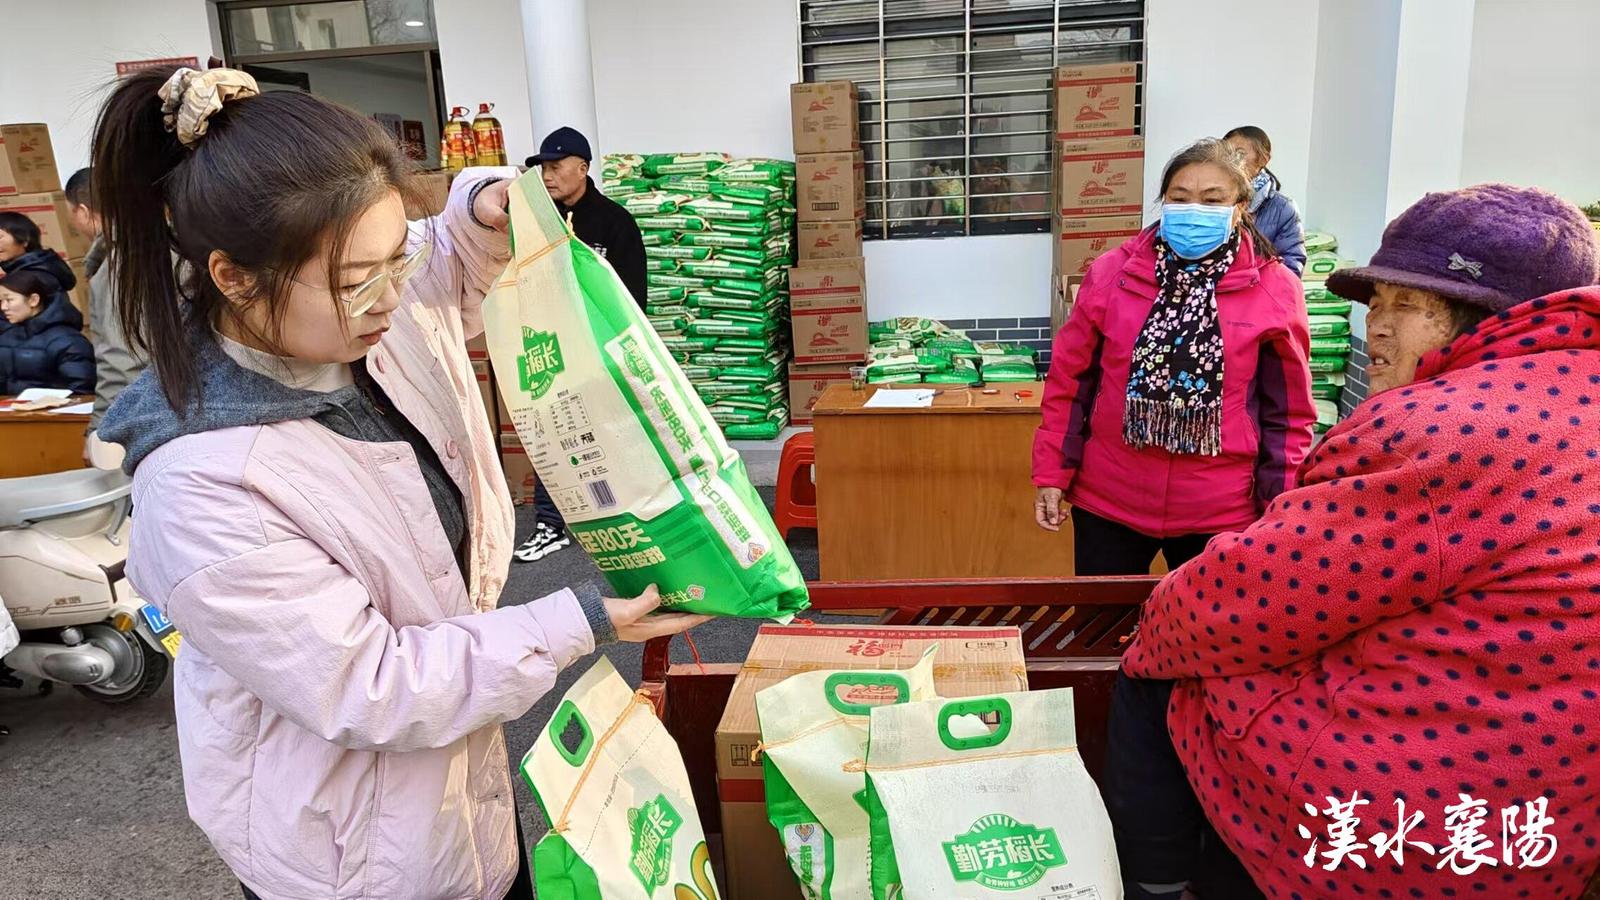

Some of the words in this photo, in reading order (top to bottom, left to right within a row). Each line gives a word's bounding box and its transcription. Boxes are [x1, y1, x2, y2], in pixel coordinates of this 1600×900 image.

[525, 340, 559, 376] 稻长
[574, 522, 652, 553] 足180天
[633, 804, 674, 885] 勤劳稻长
[951, 833, 1056, 873] 勤劳稻长
